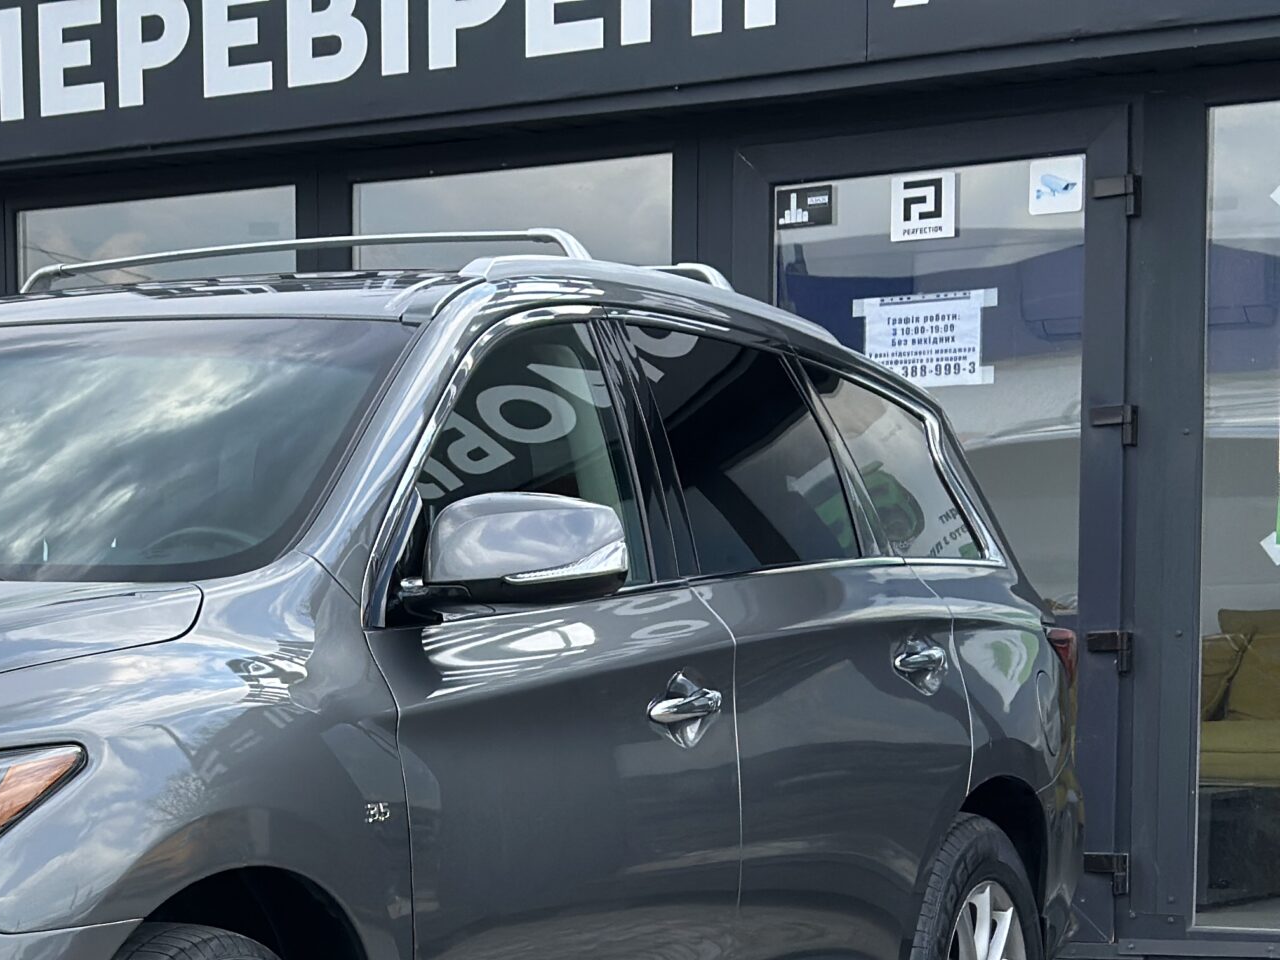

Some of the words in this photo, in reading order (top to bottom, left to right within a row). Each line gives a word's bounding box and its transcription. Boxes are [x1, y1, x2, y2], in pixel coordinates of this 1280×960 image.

[902, 225, 943, 237] PERFECTION
[887, 315, 920, 326] Графік
[901, 323, 955, 336] 10:00-19:00
[891, 337, 908, 347] Без
